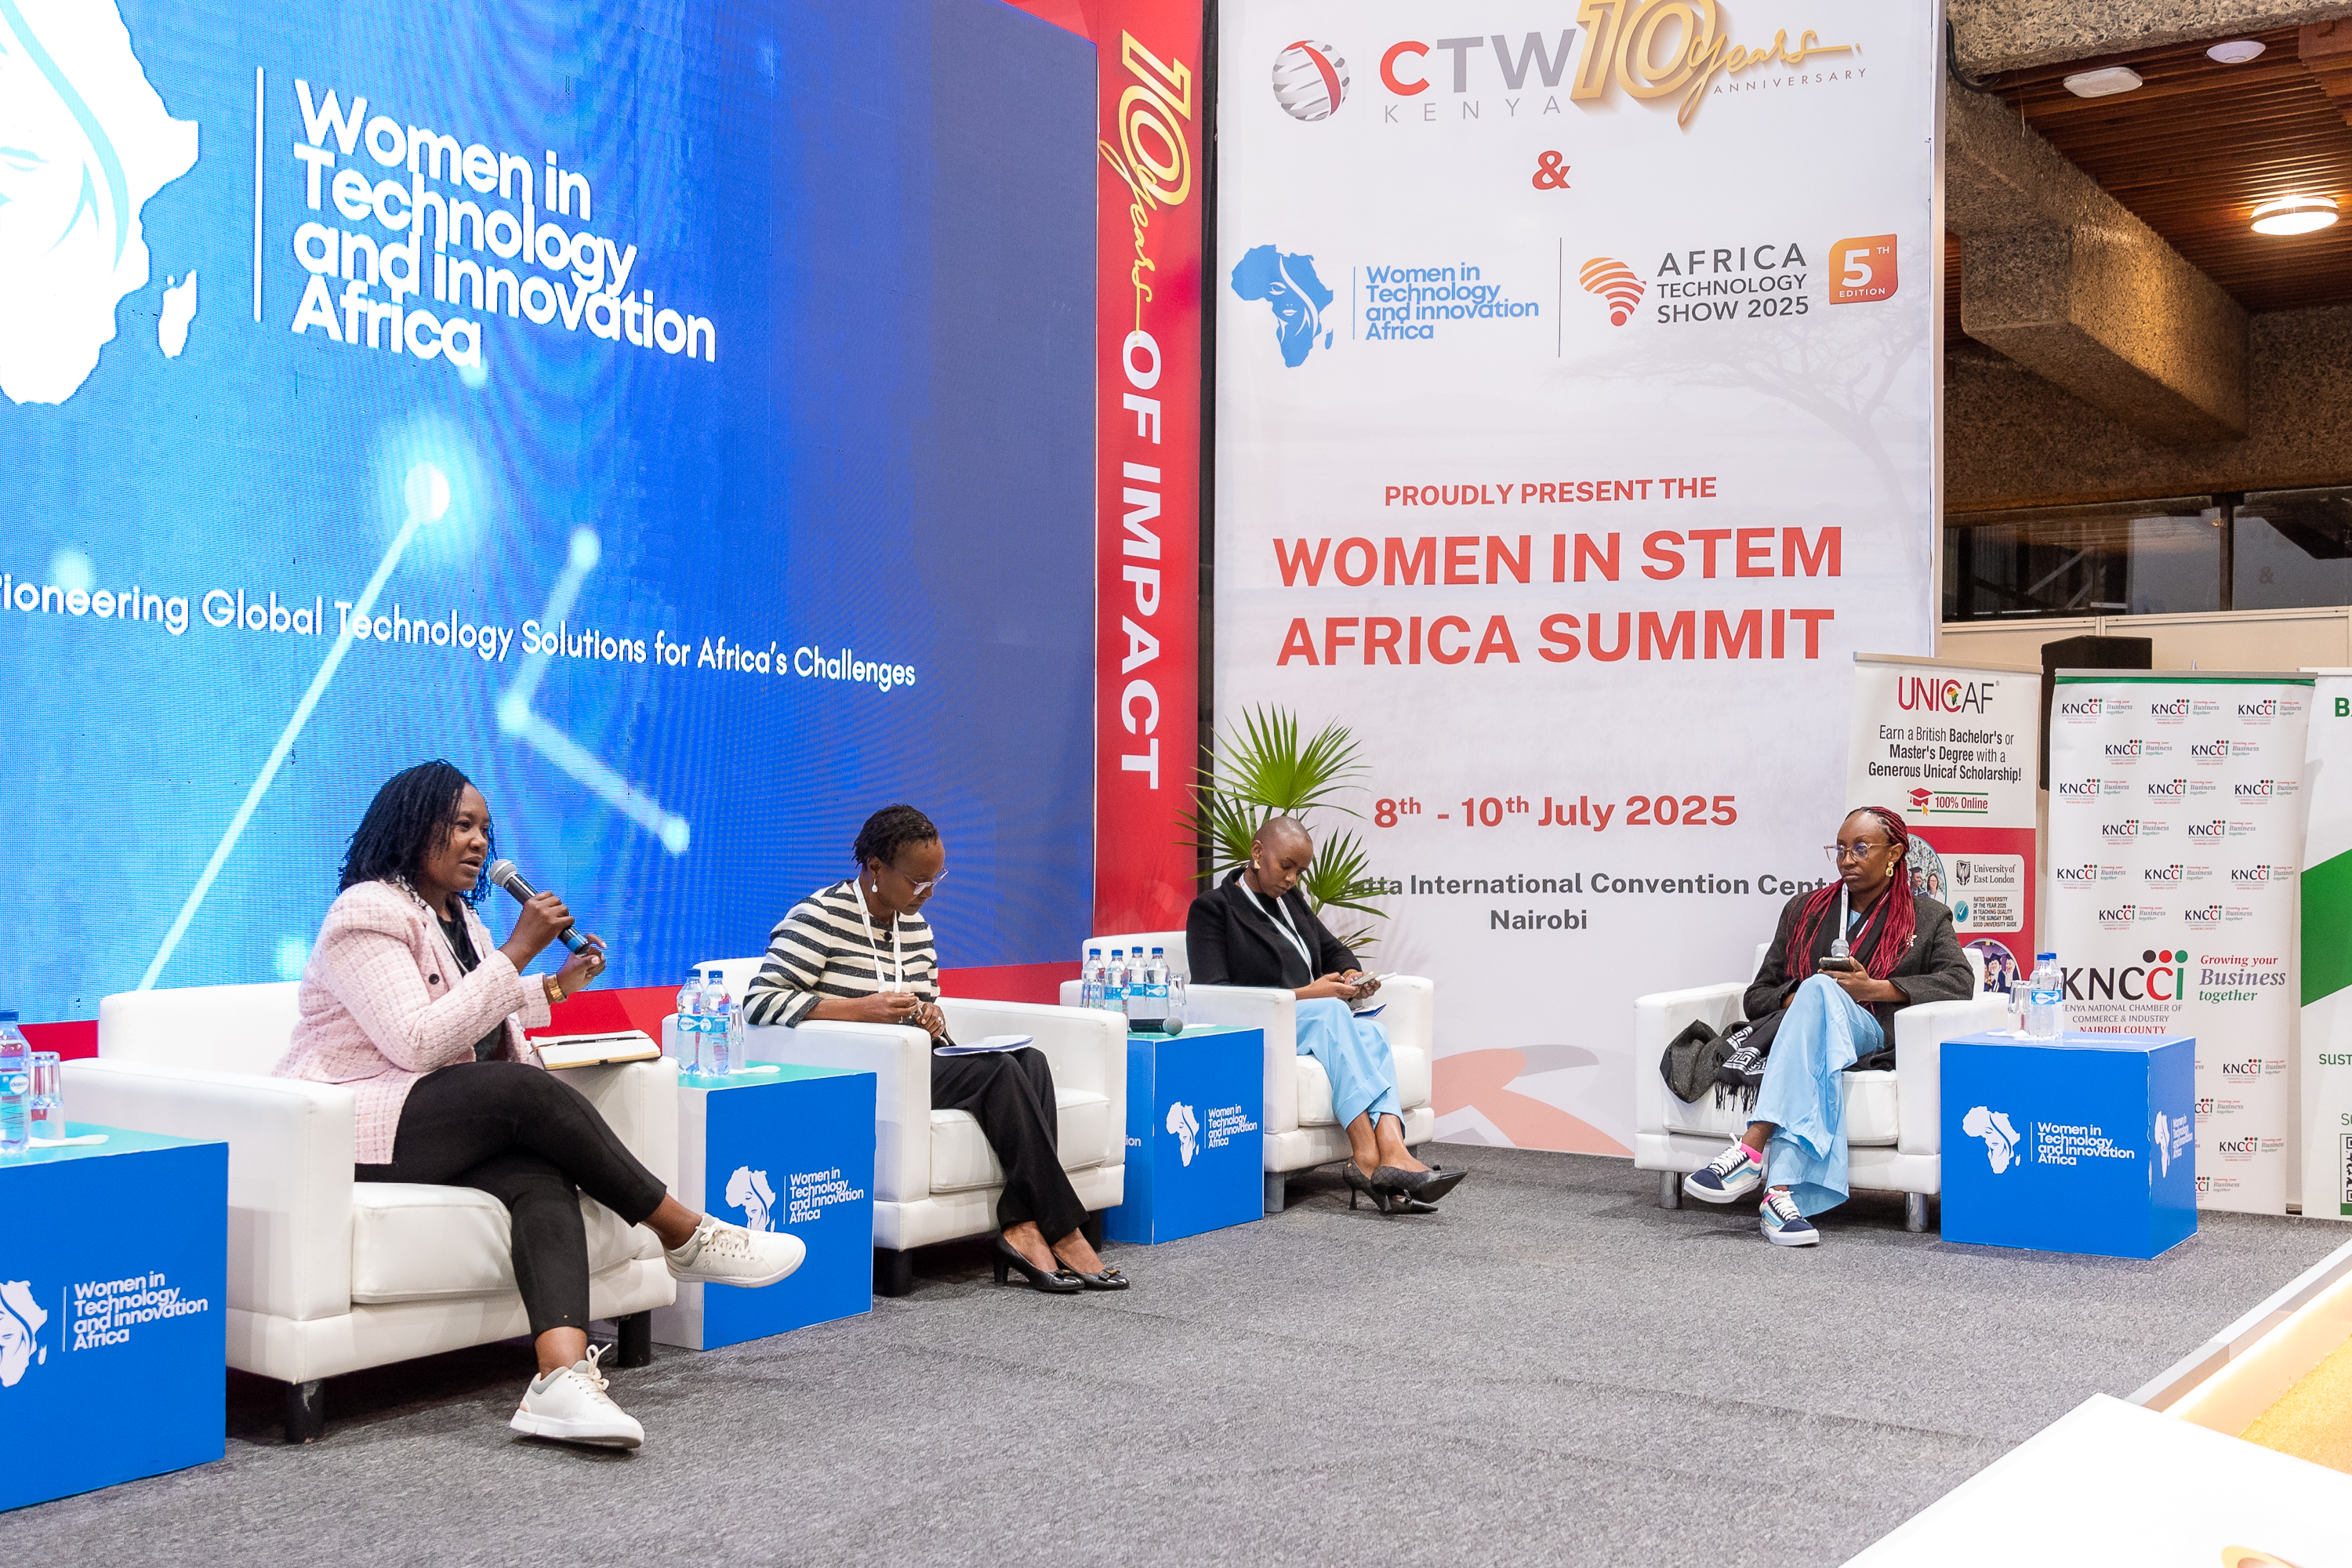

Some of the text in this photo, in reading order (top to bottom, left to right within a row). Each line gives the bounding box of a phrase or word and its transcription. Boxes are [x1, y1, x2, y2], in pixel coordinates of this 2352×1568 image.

[1380, 28, 1577, 96] CTW
[1570, 0, 1715, 100] 10
[1712, 67, 1868, 95] ANNIVERSARY
[1119, 29, 1191, 205] 10
[1384, 95, 1561, 124] KENYA
[294, 78, 592, 221] Women in
[1532, 150, 1571, 191] &
[294, 143, 637, 296] Technology
[1657, 242, 1806, 278] AFRICA
[1842, 245, 1890, 288] 5 TH
[1365, 261, 1481, 284] Women in
[294, 220, 716, 363] and innovation
[1365, 281, 1500, 307] Technology
[1657, 273, 1807, 300] TECHNOLOGY
[1838, 287, 1886, 299] EDITION
[292, 274, 482, 368] Africa
[1365, 299, 1539, 322] and innovation
[1657, 296, 1809, 324] SHOW 2025
[1365, 318, 1434, 341] Africa
[1385, 477, 1717, 506] PROUDLY PRESENT THE
[1121, 329, 1161, 789] OF IMPACT
[1272, 526, 1841, 586] WOMEN IN STEM
[0, 571, 915, 692] ioneering Global Technology Solutions for Africa's Challenges
[1276, 608, 1835, 666] AFRICA SUMMIT
[2335, 697, 2352, 717] B
[1880, 725, 2014, 745] Earn a British Bachelor's or
[1889, 744, 2005, 764] Master's Degree with a
[1868, 761, 2022, 784] Generous Unicaf Scholarship!
[1374, 797, 1421, 827] 8th
[1461, 795, 1530, 826] 10th
[1538, 796, 1615, 832] July
[1626, 795, 1737, 825] 2025
[1935, 796, 1988, 809] 100% Online
[1973, 864, 2016, 874] University of
[1973, 874, 2015, 884] East London
[1410, 873, 1583, 895] International
[1591, 873, 1749, 895] Convention
[1758, 875, 1836, 895] Cent
[1490, 909, 1588, 930] Nairobi
[2200, 954, 2278, 967] Growing your
[2199, 968, 2286, 985] Business
[2199, 989, 2258, 1004] together
[1208, 1104, 1241, 1119] Women in
[1208, 1114, 1247, 1130] Technology
[1208, 1121, 1258, 1139] and innovation
[2038, 1122, 2101, 1136] Women in
[1208, 1137, 1229, 1149] Africa
[2038, 1133, 2113, 1150] Technology
[2038, 1143, 2135, 1160] and innovation
[2038, 1152, 2077, 1166] Africa
[790, 1167, 840, 1186] Women in
[789, 1178, 848, 1200] Technology
[789, 1188, 864, 1212] and innovation
[789, 1207, 821, 1225] Africa
[74, 1271, 165, 1299] Women in
[74, 1287, 180, 1317] Technology
[74, 1298, 209, 1334] and innovation
[73, 1328, 130, 1352] Africa
